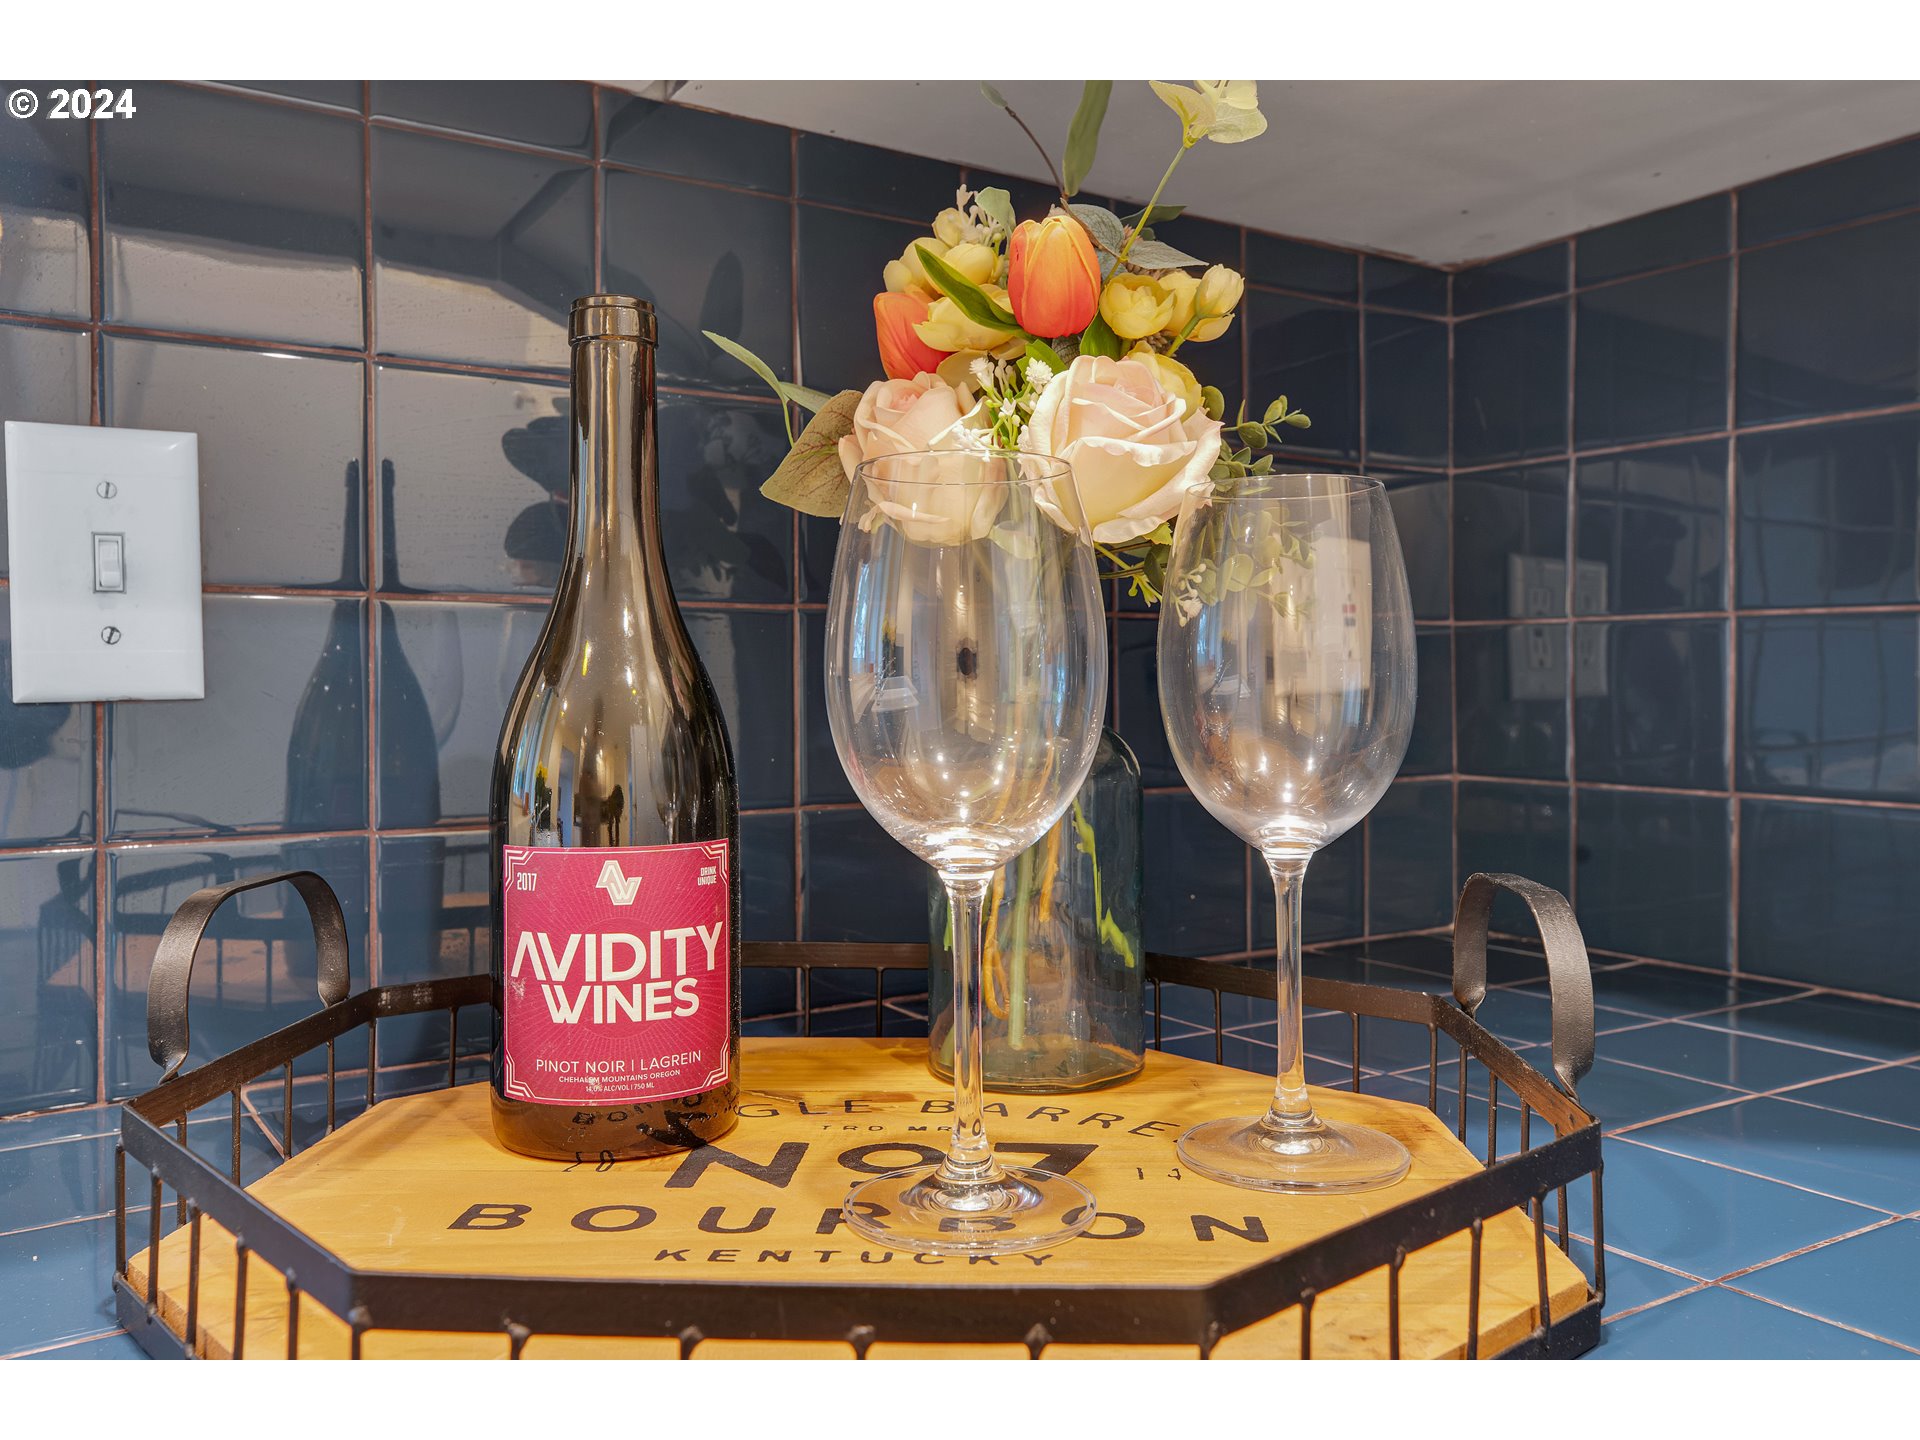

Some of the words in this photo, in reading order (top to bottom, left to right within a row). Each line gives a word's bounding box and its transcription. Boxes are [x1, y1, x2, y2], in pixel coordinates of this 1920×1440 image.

[697, 874, 717, 886] UNIQUE
[700, 865, 717, 877] DRINK
[516, 871, 538, 892] 2017
[510, 921, 724, 982] AVIDITY
[541, 977, 700, 1025] WINES
[535, 1058, 580, 1074] PINOT
[585, 1059, 626, 1074] NOIR
[640, 1049, 702, 1072] LAGREIN
[601, 1072, 649, 1084] MOUNTAINS
[649, 1069, 682, 1080] OREGON
[633, 1081, 646, 1091] 750
[646, 1081, 656, 1090] ML
[920, 1099, 1182, 1138] BARRE
[654, 1248, 1054, 1266] KENTUCKY
